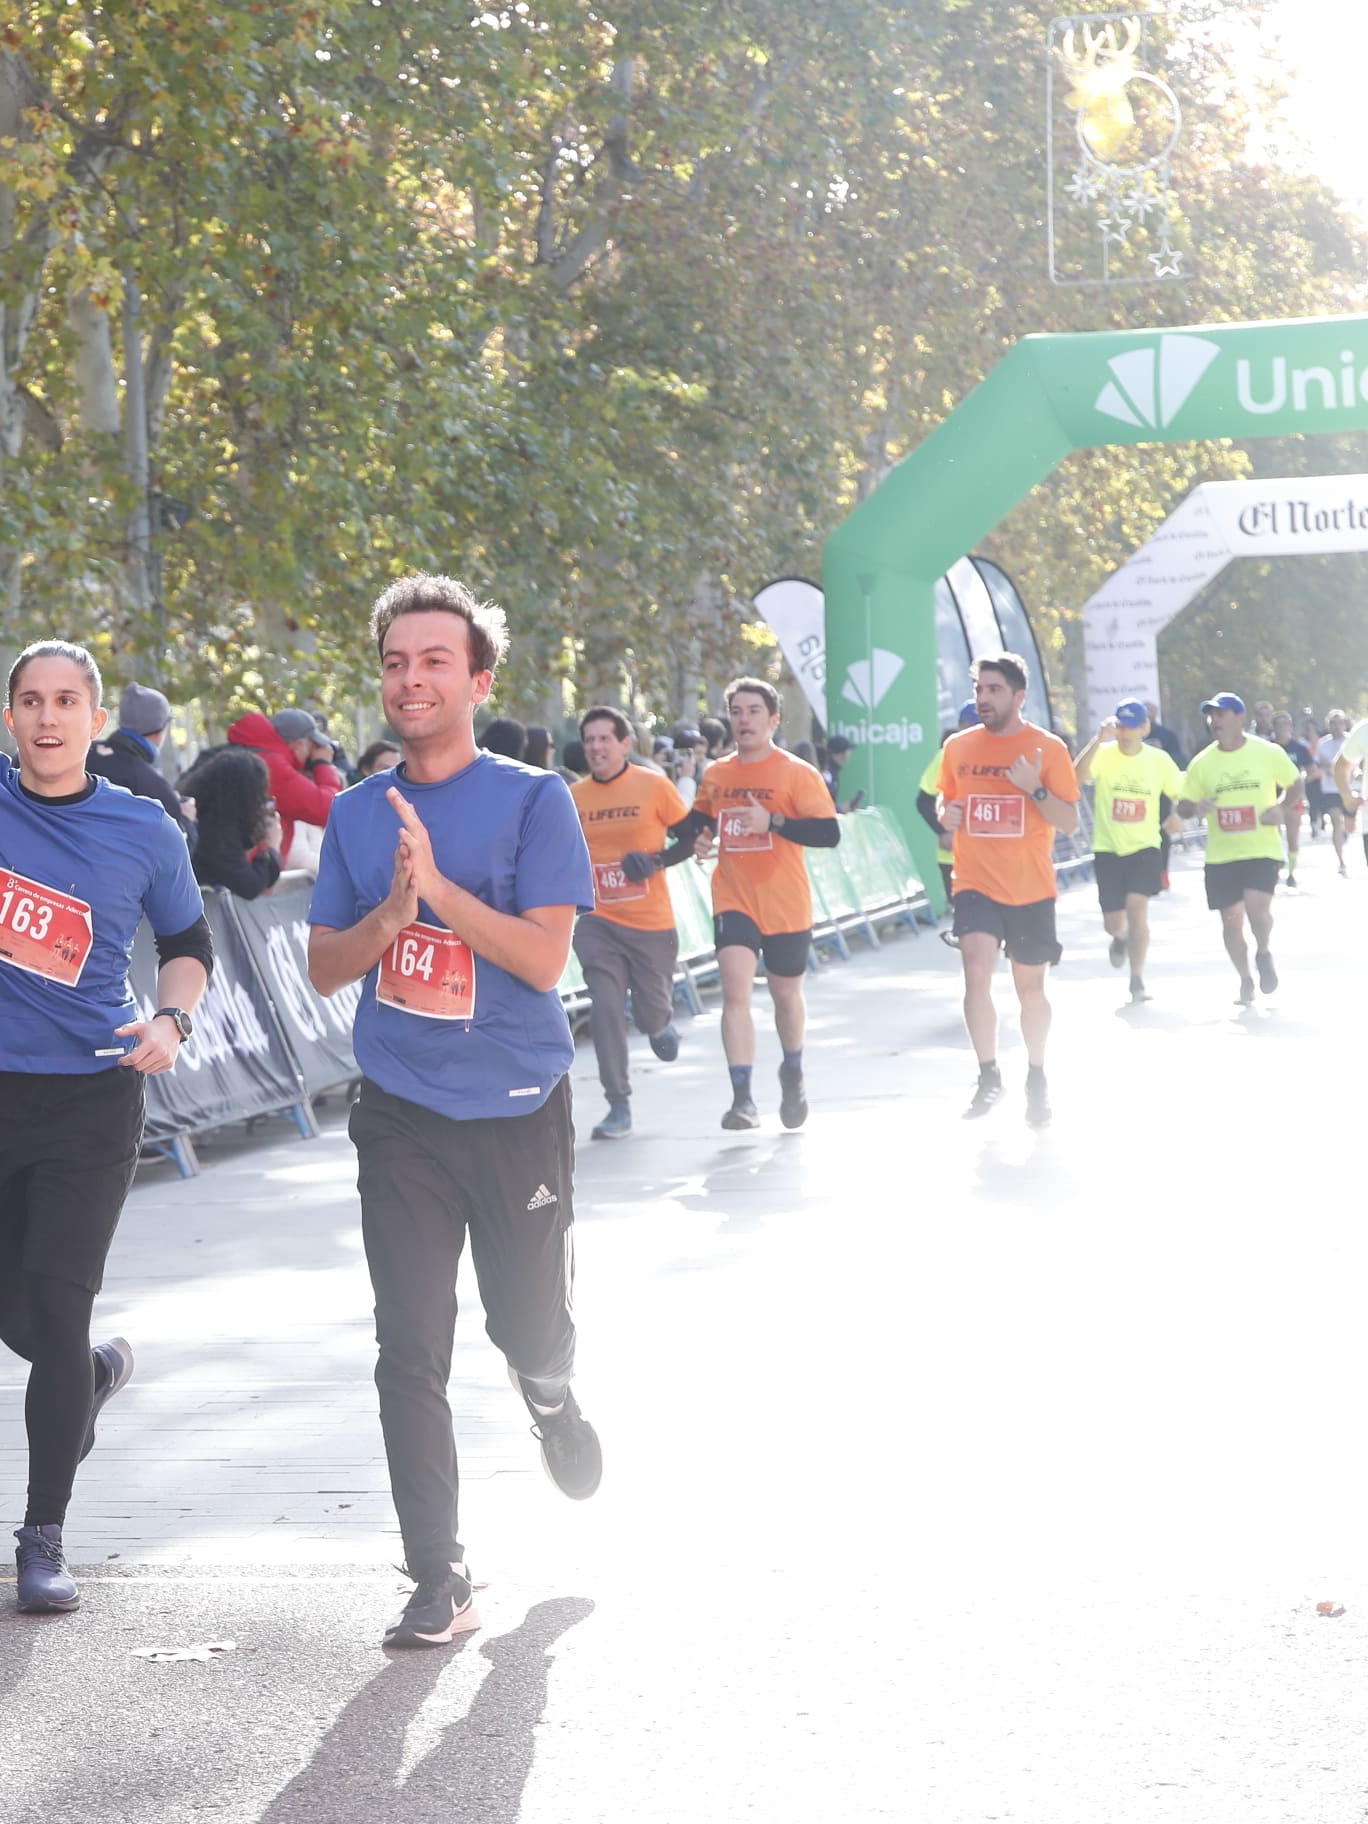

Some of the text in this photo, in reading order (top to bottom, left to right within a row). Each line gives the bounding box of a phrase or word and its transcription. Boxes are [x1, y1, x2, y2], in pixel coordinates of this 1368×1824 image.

[1237, 350, 1368, 414] Uni
[1238, 501, 1278, 537] El
[589, 806, 640, 822] LIFETEC
[974, 803, 1000, 822] 461
[724, 818, 744, 837] 46
[600, 870, 627, 888] 462
[392, 936, 435, 982] 164
[527, 1194, 558, 1211] adidas
